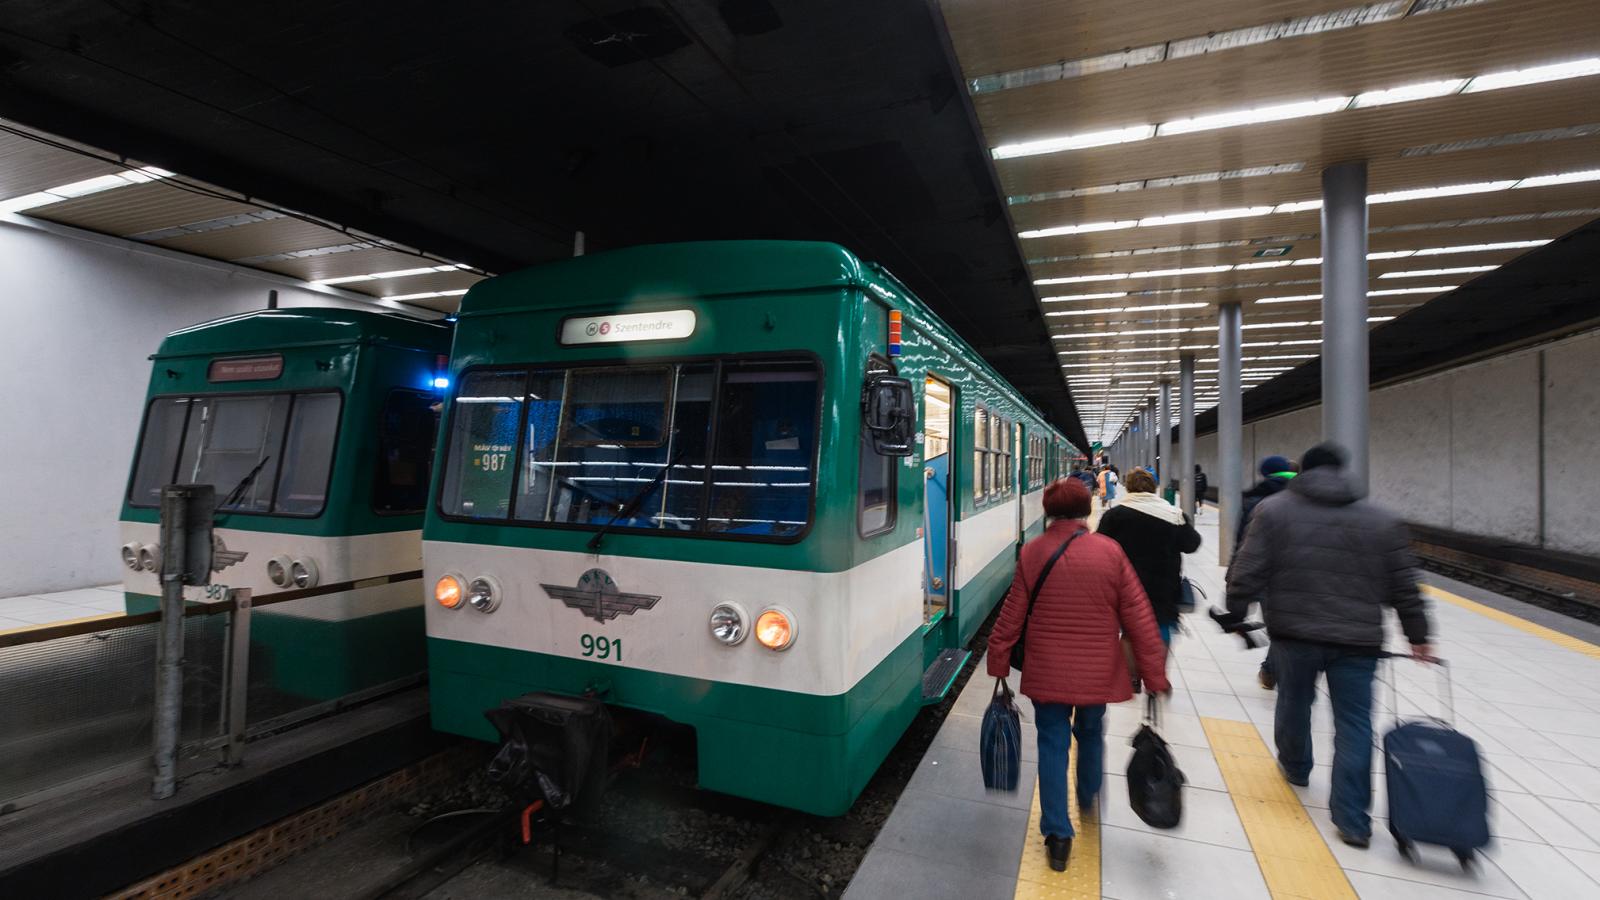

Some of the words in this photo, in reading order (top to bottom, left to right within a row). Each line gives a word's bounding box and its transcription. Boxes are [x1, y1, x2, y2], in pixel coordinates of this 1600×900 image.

[615, 320, 673, 333] Szentendre
[482, 453, 507, 471] 987
[580, 633, 622, 661] 991
